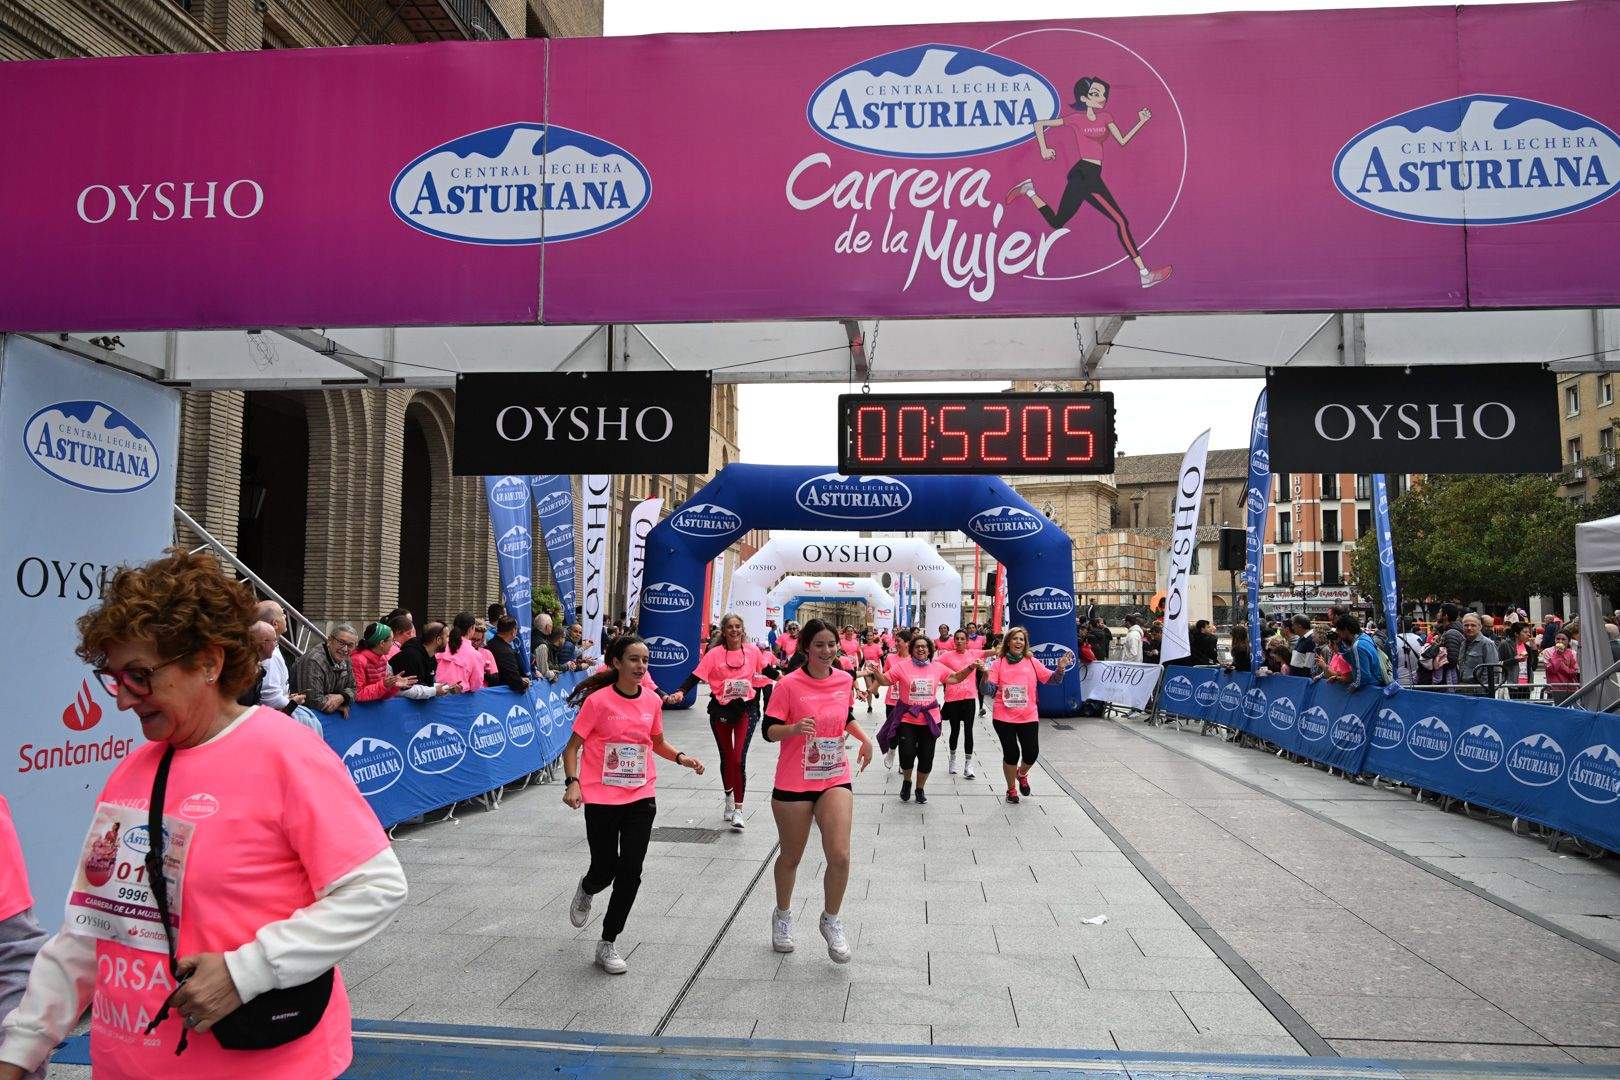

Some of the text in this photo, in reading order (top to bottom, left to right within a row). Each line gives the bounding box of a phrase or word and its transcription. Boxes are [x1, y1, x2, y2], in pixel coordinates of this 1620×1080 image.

[866, 81, 1033, 96] CENTRAL LECHERA
[827, 88, 1037, 130] ASTURIANA
[1402, 136, 1598, 155] CENTRAL LECHERA
[451, 162, 623, 179] CENTRAL LECHERA
[786, 152, 992, 211] Carrera
[1357, 146, 1611, 193] ASTURIANA
[77, 180, 265, 223] OYSHO
[410, 170, 631, 216] ASTURIANA
[835, 202, 1070, 302] de la Mujer
[496, 405, 673, 442] OYSHO
[1314, 402, 1516, 441] OYSHO
[34, 422, 151, 478] ASTURIANA
[58, 423, 149, 454] CENTRAL LECHERA
[804, 485, 903, 507] ASTURIANA
[674, 514, 736, 530] ASTURIANA
[974, 519, 1039, 532] ASTURIANA
[802, 544, 892, 563] OYSHO
[1168, 466, 1200, 621] OYSHO
[17, 557, 120, 600] OYSH
[649, 649, 685, 660] TURIANA
[18, 736, 134, 774] Santander
[413, 742, 464, 766] ASTURIANA
[1457, 738, 1499, 763] ASTURIANA
[1509, 749, 1560, 777] ASTURIANA
[352, 758, 401, 785] STURIANA
[1570, 760, 1619, 793] ASTURIAN
[117, 861, 147, 883] 01
[118, 887, 149, 903] 9996
[76, 914, 111, 931] OYSHO
[114, 904, 126, 914] DE
[126, 905, 137, 915] LA
[139, 928, 169, 942] Santan
